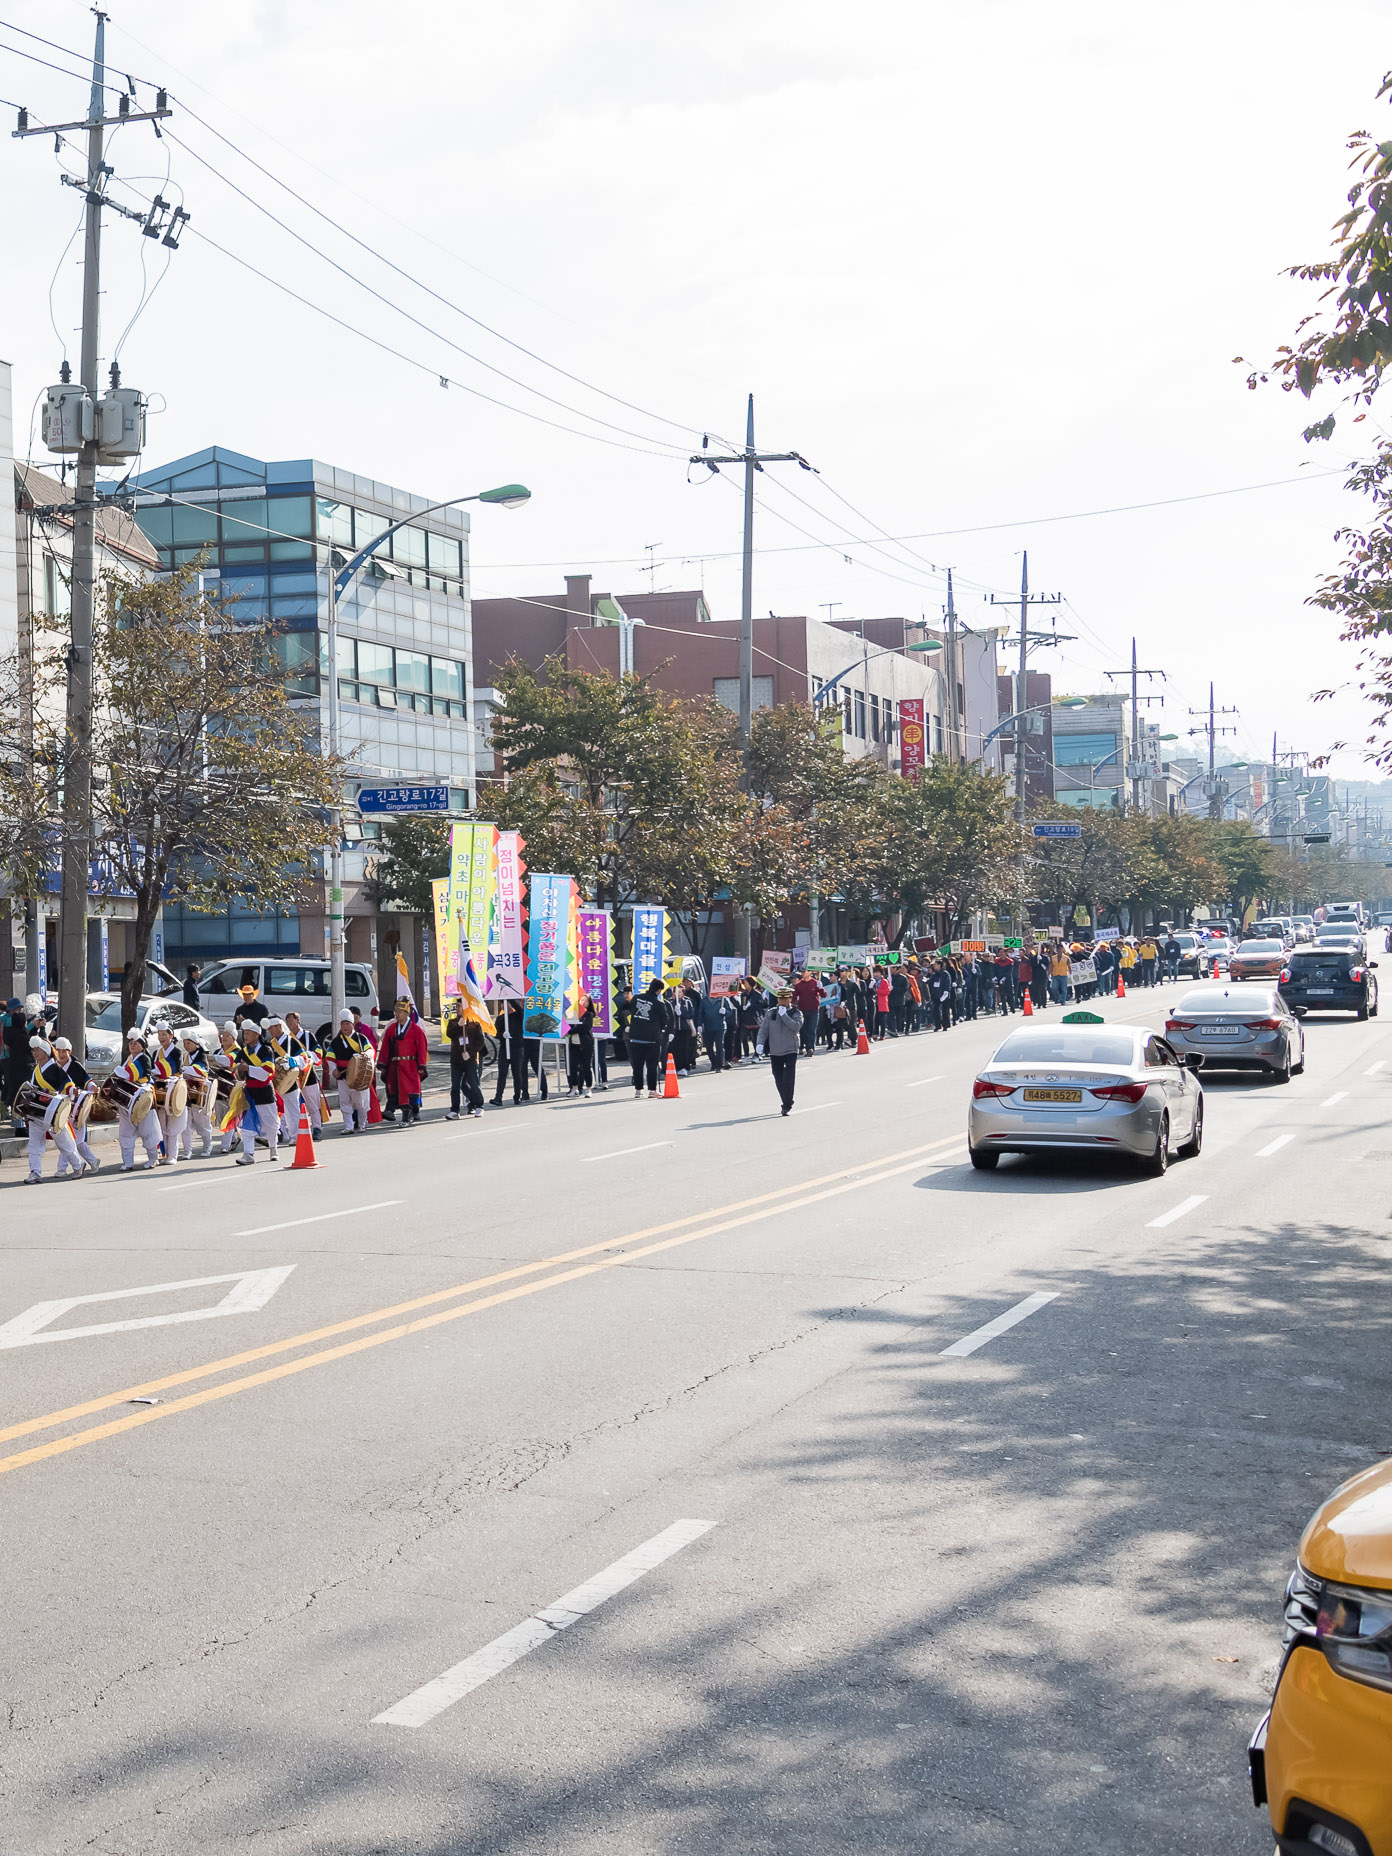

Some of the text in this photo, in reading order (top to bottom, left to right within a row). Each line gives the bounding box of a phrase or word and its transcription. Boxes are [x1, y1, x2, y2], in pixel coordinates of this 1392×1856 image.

[377, 787, 447, 803] 긴고랑로17길
[386, 801, 447, 811] Gingorang-ro 17-gil
[584, 917, 603, 971] 아름다운
[525, 996, 562, 1013] 중곡4동
[1071, 1014, 1094, 1022] TAXI
[1053, 1091, 1078, 1101] 5527
